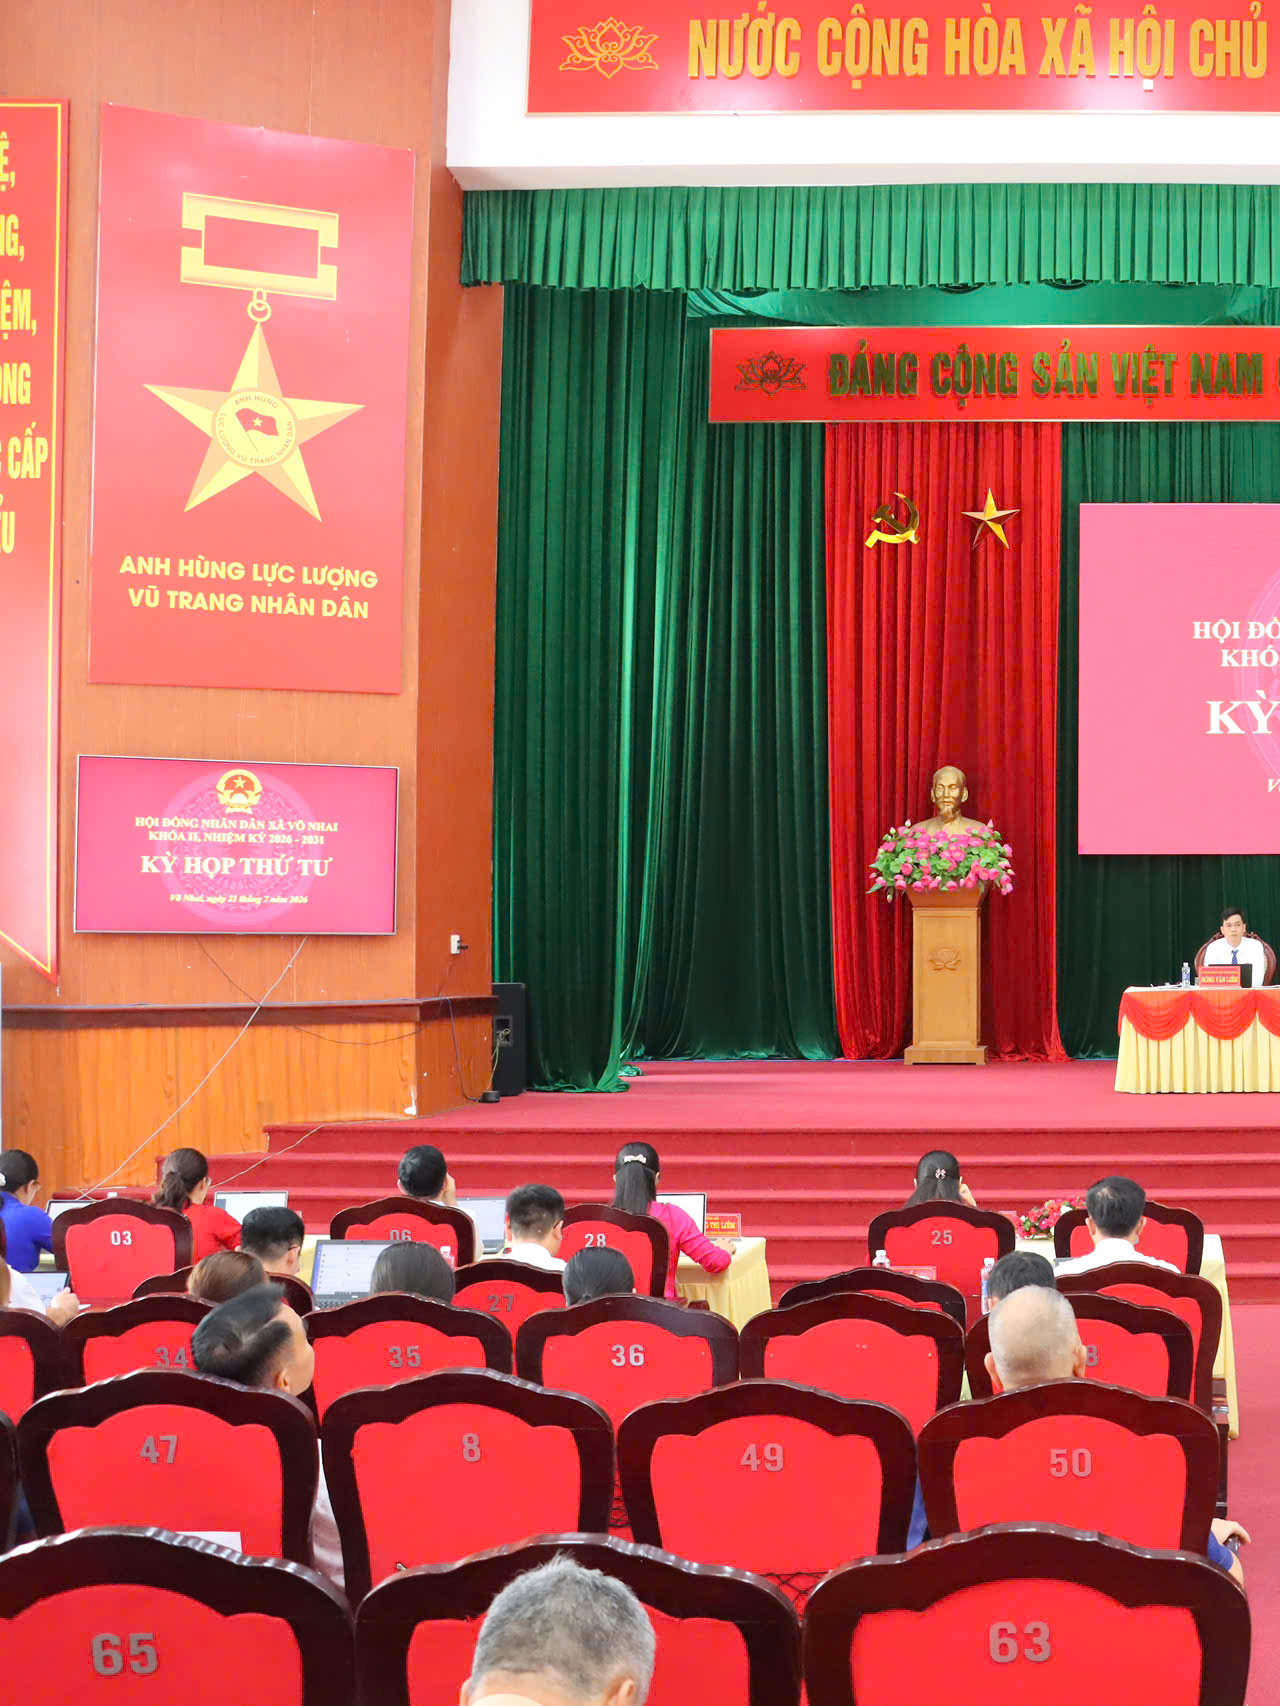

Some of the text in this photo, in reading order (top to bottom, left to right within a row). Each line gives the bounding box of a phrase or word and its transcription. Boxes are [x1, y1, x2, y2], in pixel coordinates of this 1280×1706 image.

[688, 1, 800, 78] NƯỚC
[817, 4, 929, 89] CỘNG
[945, 2, 1026, 76] HÒA
[1040, 6, 1096, 78] XÃ
[1109, 5, 1174, 90] HỘI
[1189, 1, 1267, 78] CHỦ
[829, 338, 918, 396] ĐẢNG
[932, 344, 1018, 408] CỘNG
[1032, 339, 1098, 397] SẢN
[1111, 343, 1177, 408] VIỆT
[1190, 352, 1263, 397] NAM
[7, 421, 48, 480] CẤP
[119, 553, 378, 592] ANH HÙNG LỰC LƯỢNG
[128, 585, 369, 620] VŨ TRANG NHÂN DÂN
[1193, 619, 1242, 643] HỘI
[184, 856, 235, 878] HỌP
[240, 854, 294, 876] THỨ
[297, 856, 333, 877] TƯ
[110, 1230, 133, 1246] 03
[584, 1233, 607, 1248] 28
[931, 1229, 953, 1246] 25
[487, 1294, 514, 1312] 27
[388, 1345, 421, 1368] 35
[611, 1344, 645, 1367] 36
[139, 1435, 178, 1464] 47
[462, 1433, 481, 1462] 8
[740, 1443, 784, 1472] 49
[1049, 1448, 1092, 1478] 50
[91, 1632, 159, 1676] 65
[988, 1620, 1052, 1663] 63
